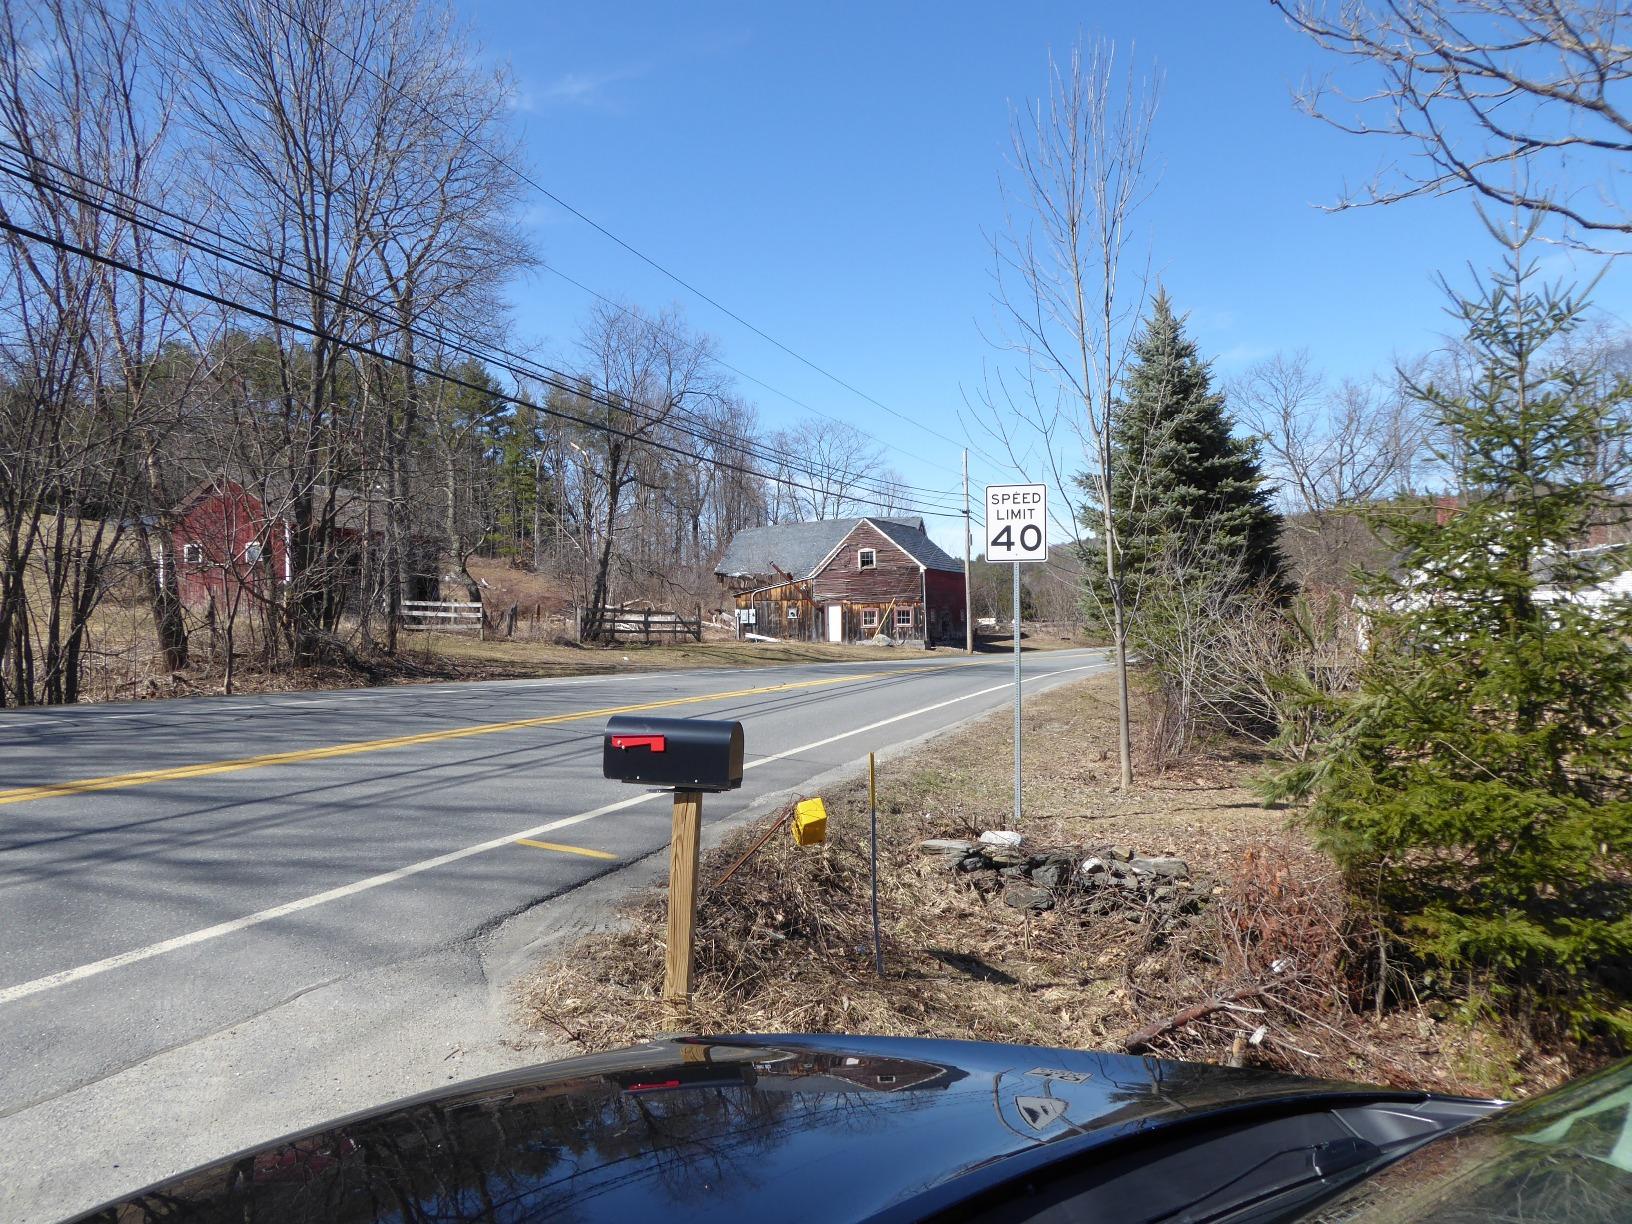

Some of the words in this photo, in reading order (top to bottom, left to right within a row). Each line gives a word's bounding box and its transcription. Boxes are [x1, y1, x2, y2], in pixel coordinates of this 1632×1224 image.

[991, 492, 1041, 505] SPEED
[996, 508, 1036, 521] LIMIT
[991, 524, 1042, 552] 40
